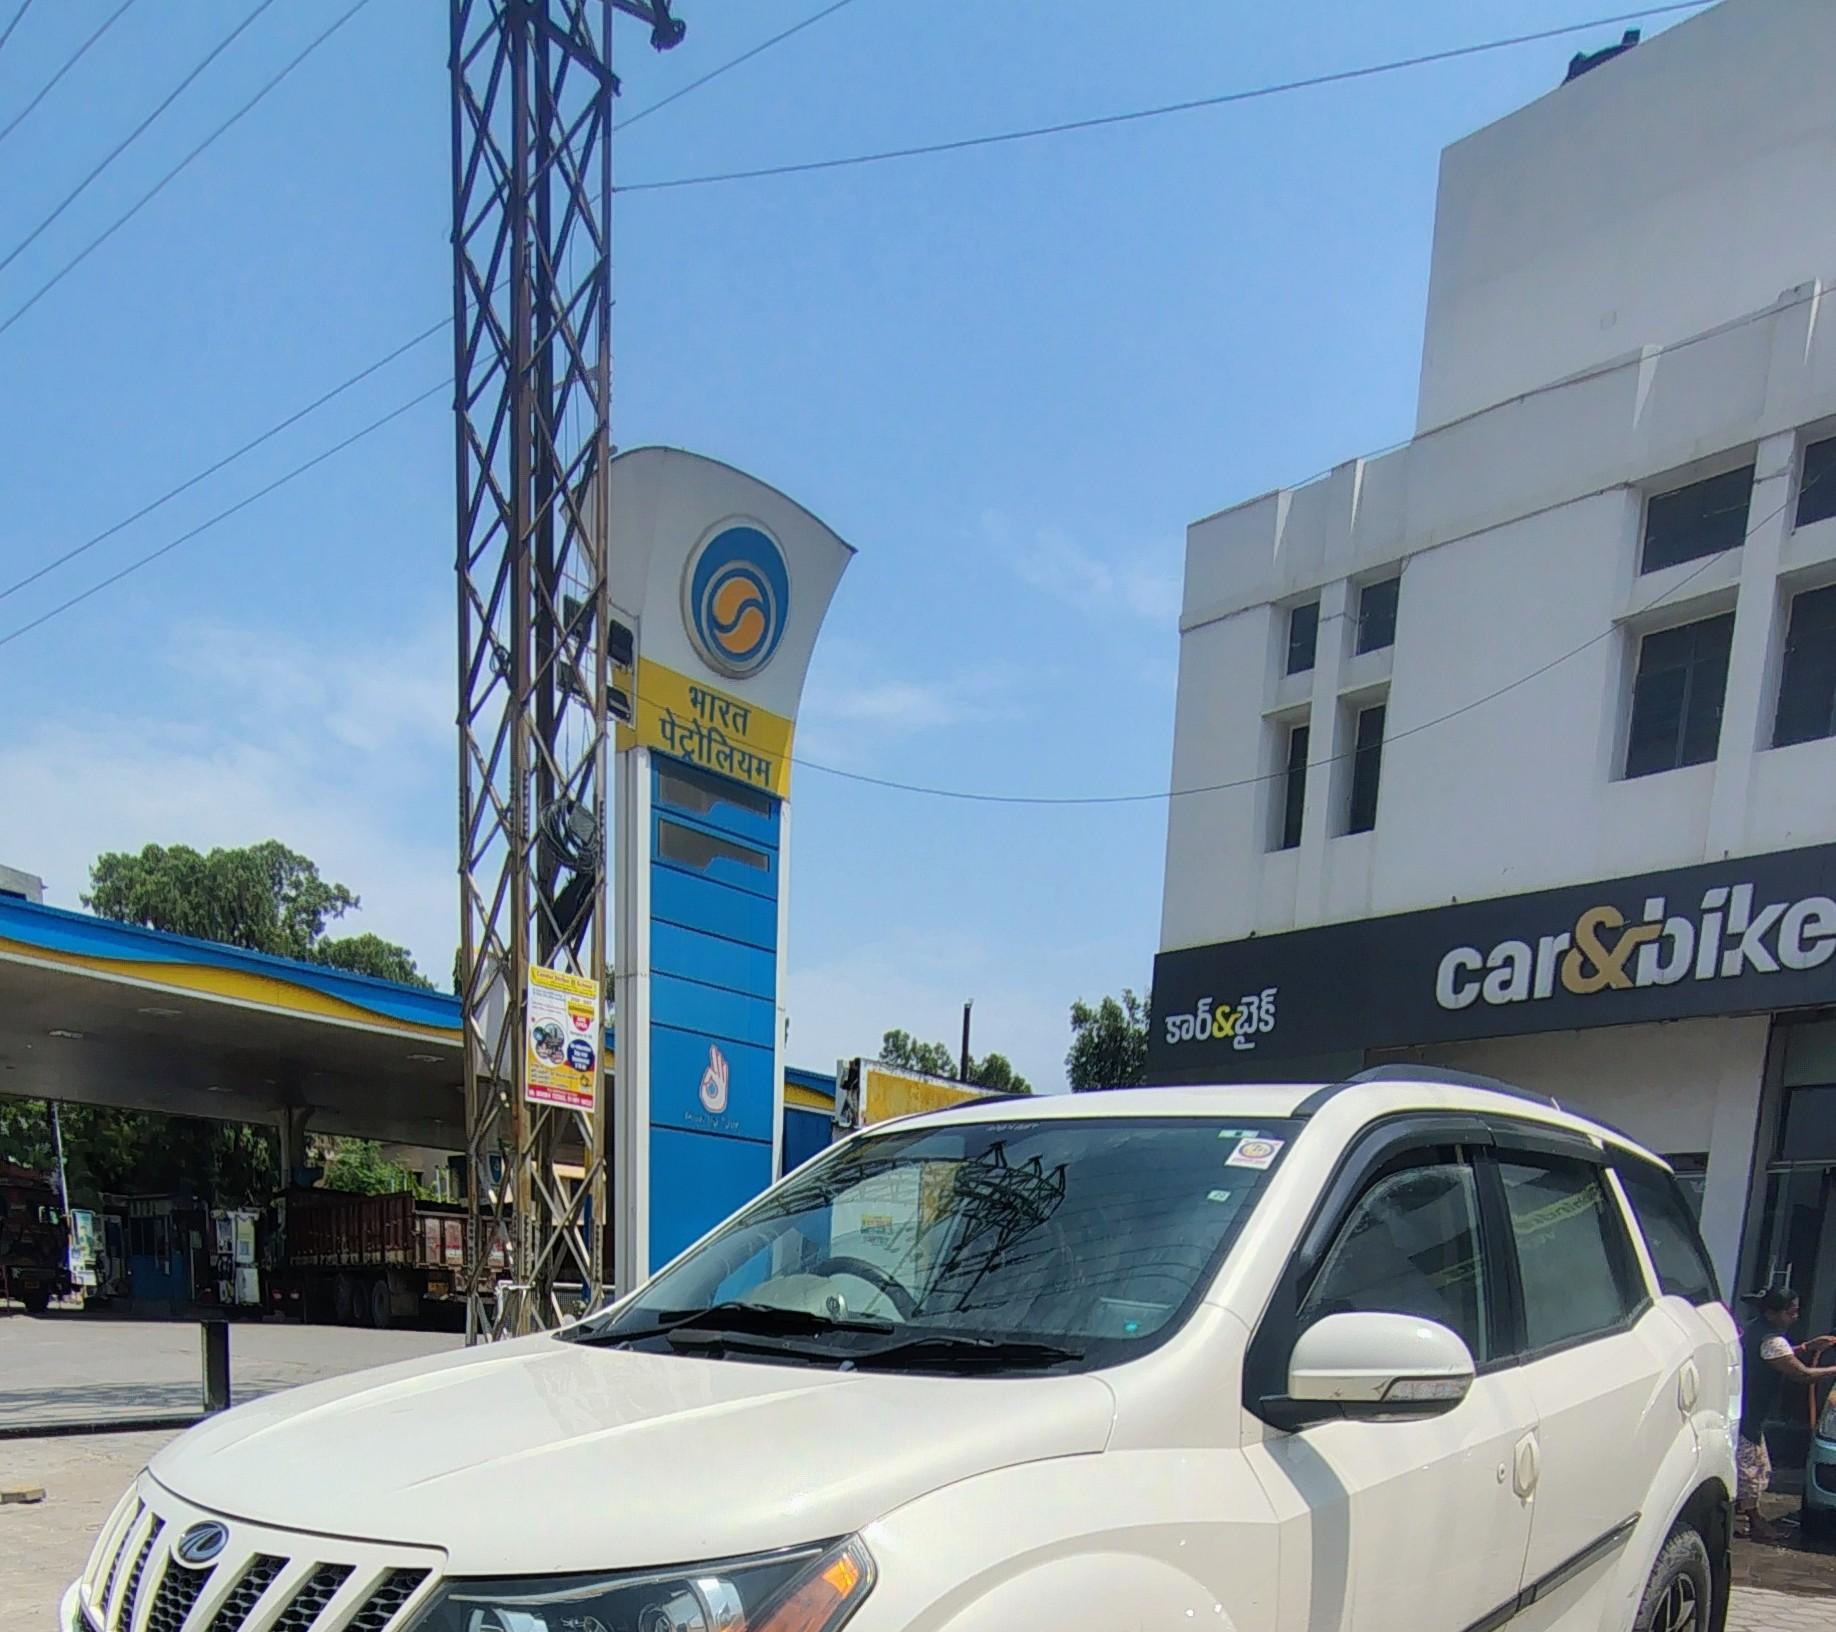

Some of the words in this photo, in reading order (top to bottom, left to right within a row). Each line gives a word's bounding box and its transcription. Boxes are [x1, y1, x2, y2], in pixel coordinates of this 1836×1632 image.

[658, 707, 772, 787] पेट्रोलियम
[688, 685, 752, 736] भारत
[1435, 882, 1836, 1011] car&bike
